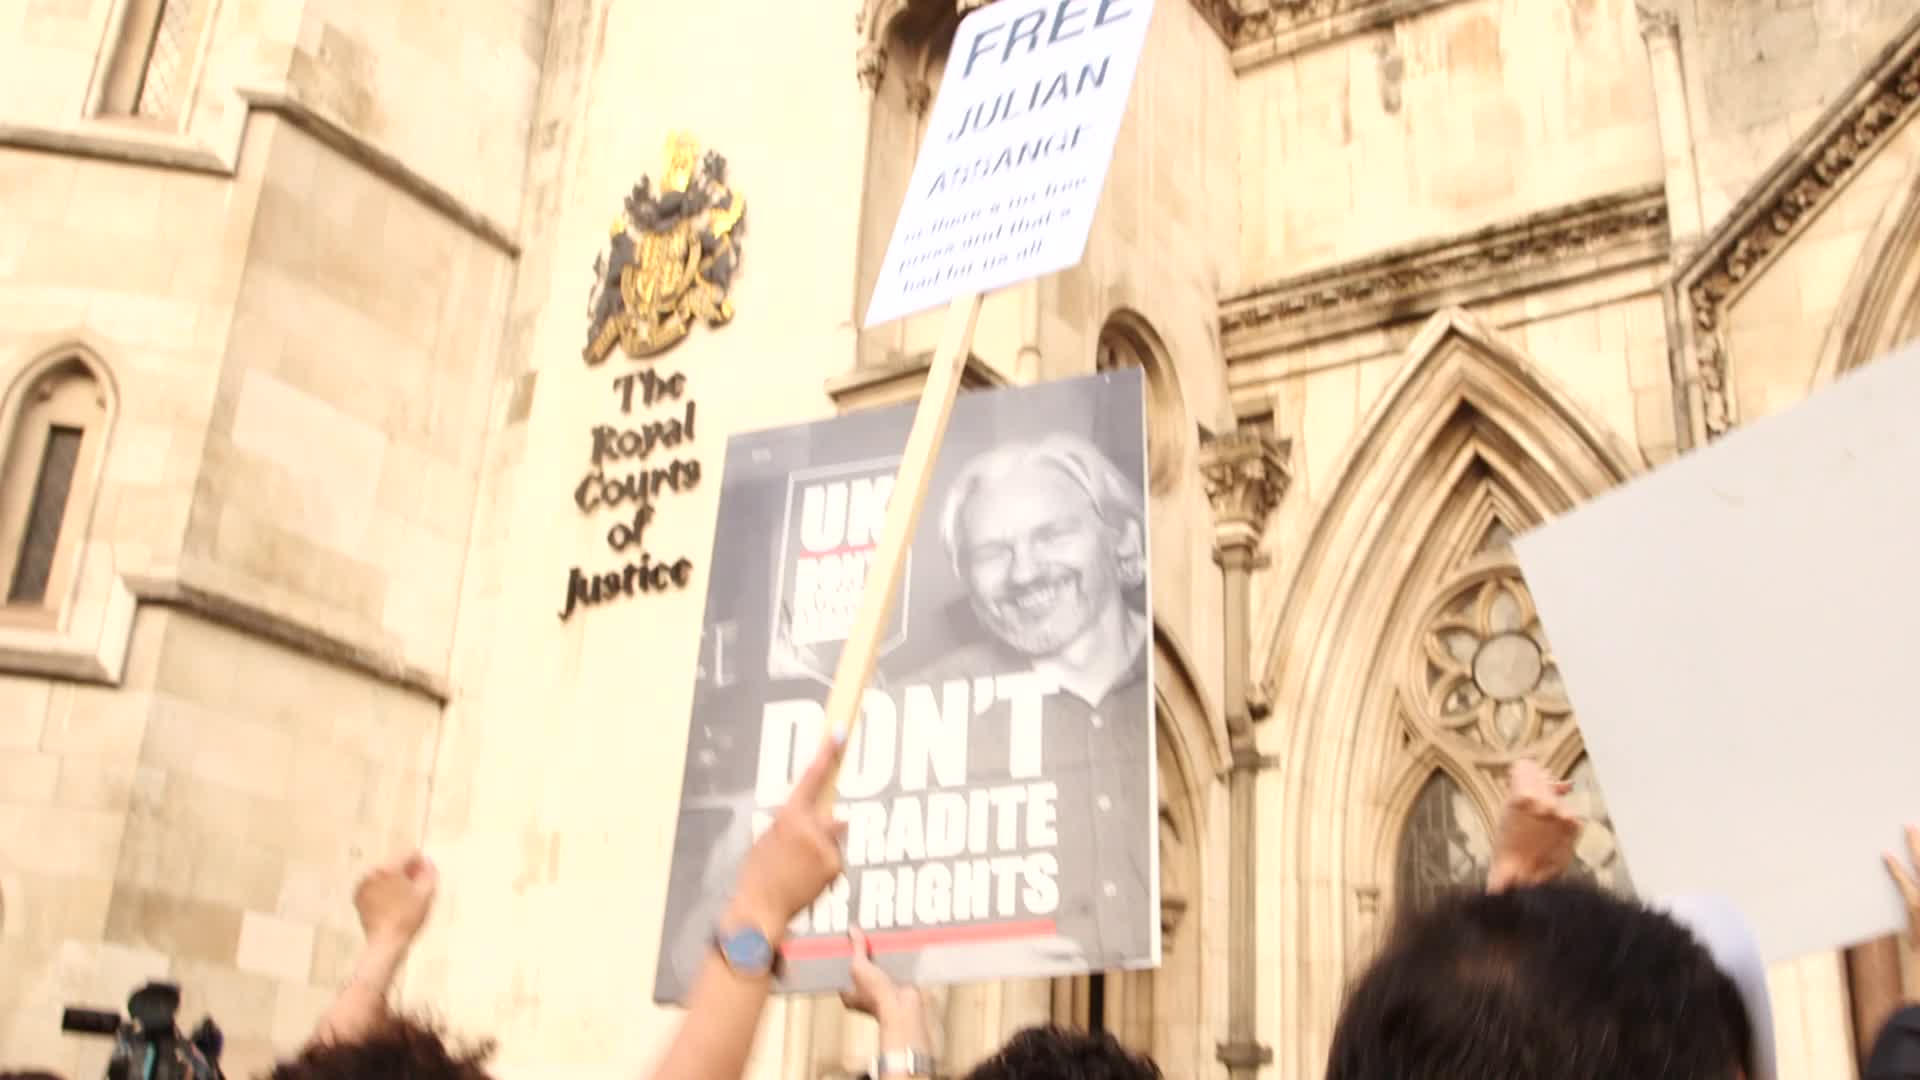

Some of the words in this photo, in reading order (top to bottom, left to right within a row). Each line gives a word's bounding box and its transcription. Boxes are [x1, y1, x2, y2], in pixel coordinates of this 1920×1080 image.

[947, 55, 1111, 141] JULIAN
[613, 367, 687, 414] The
[591, 400, 696, 466] Royal
[574, 458, 701, 515] Courts
[607, 503, 655, 551] of
[557, 552, 693, 622] Justice
[755, 671, 1058, 808] DON'T
[752, 782, 1058, 866] RADITE
[858, 852, 1059, 929] RIGHTS
